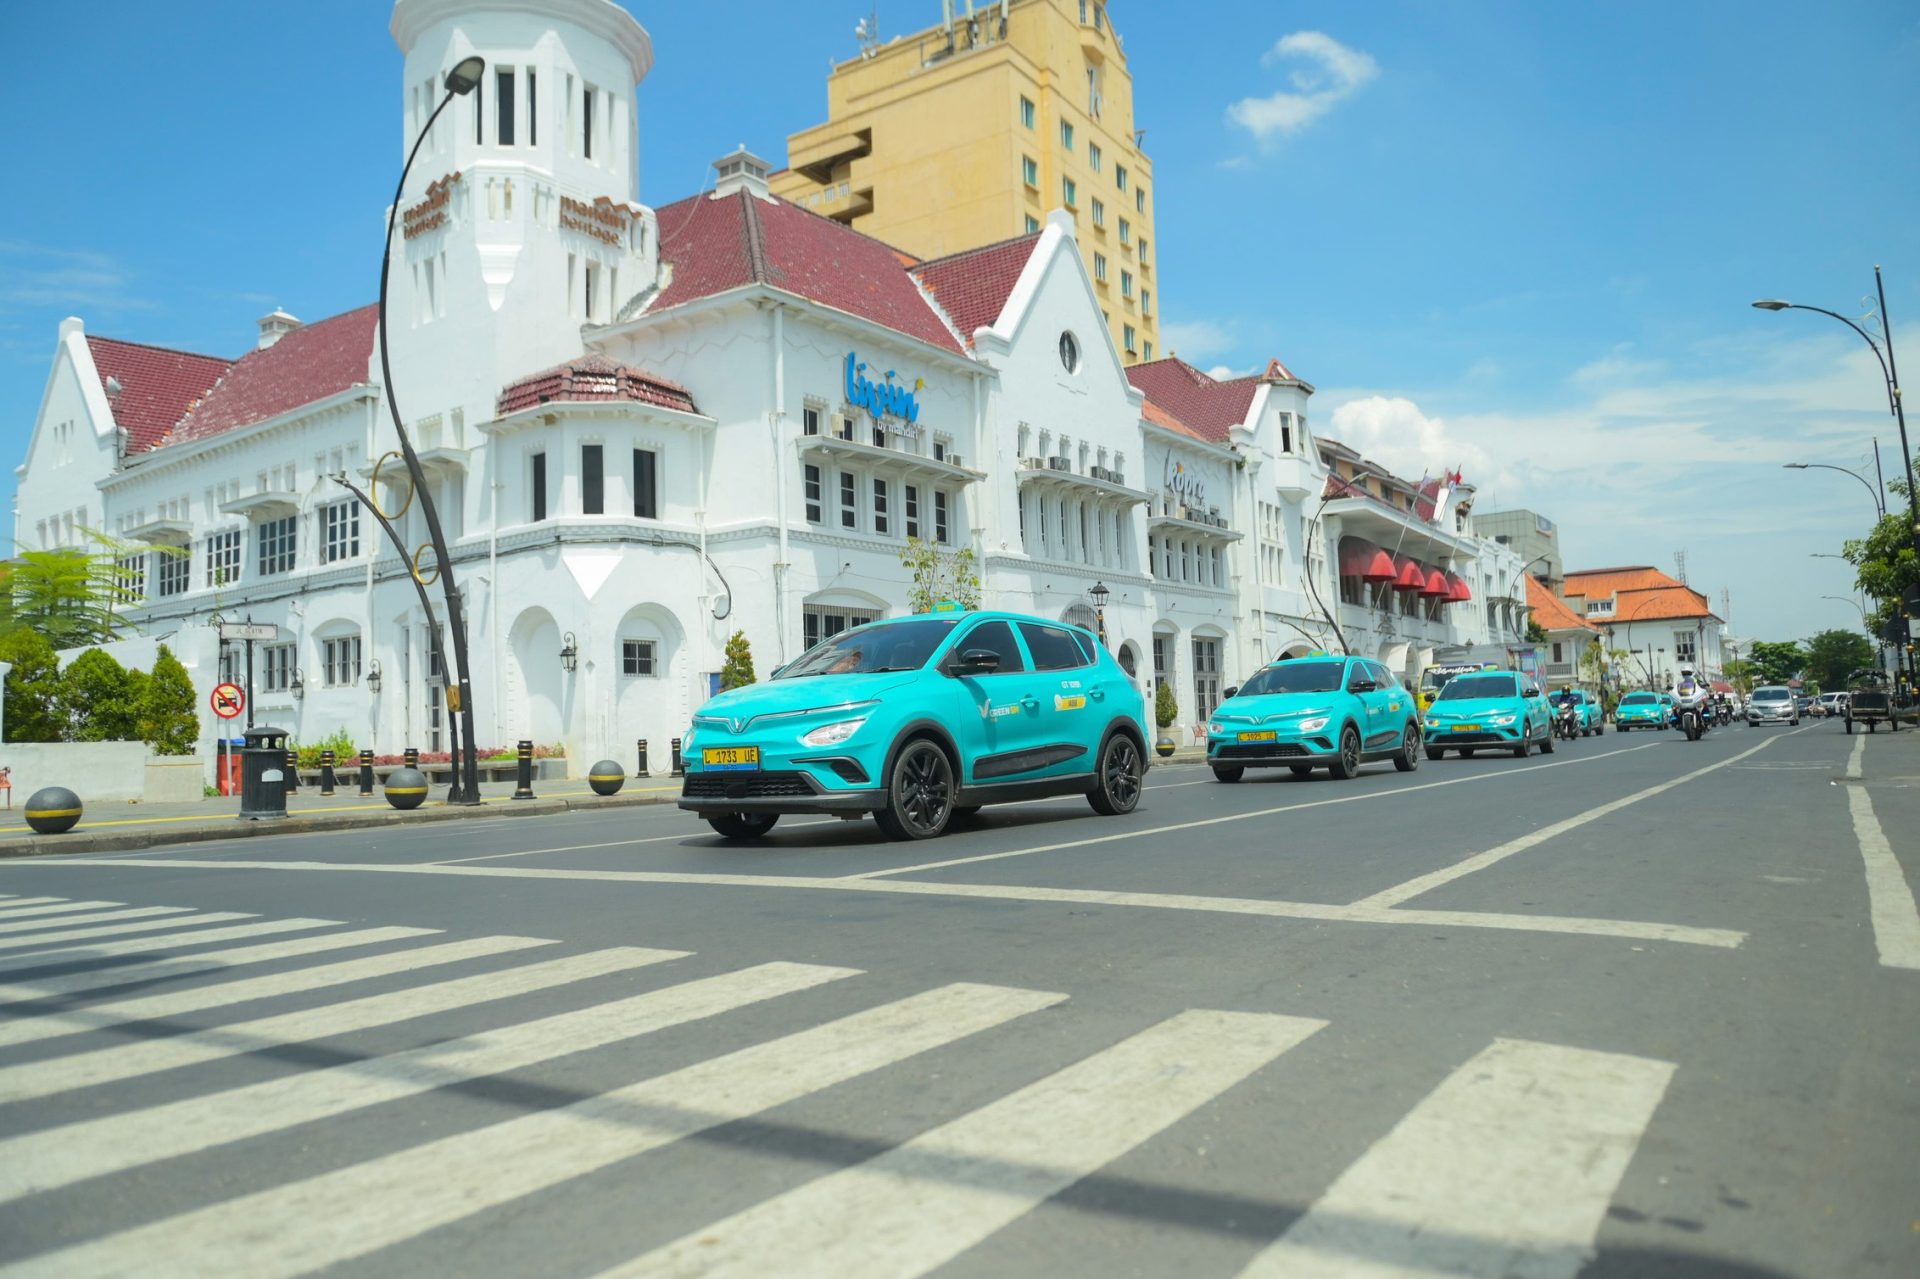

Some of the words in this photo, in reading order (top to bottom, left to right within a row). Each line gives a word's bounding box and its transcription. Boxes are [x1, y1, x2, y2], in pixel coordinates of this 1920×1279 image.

[560, 210, 619, 246] heritage
[704, 751, 711, 764] L
[716, 750, 737, 764] 1733
[744, 749, 756, 762] UE
